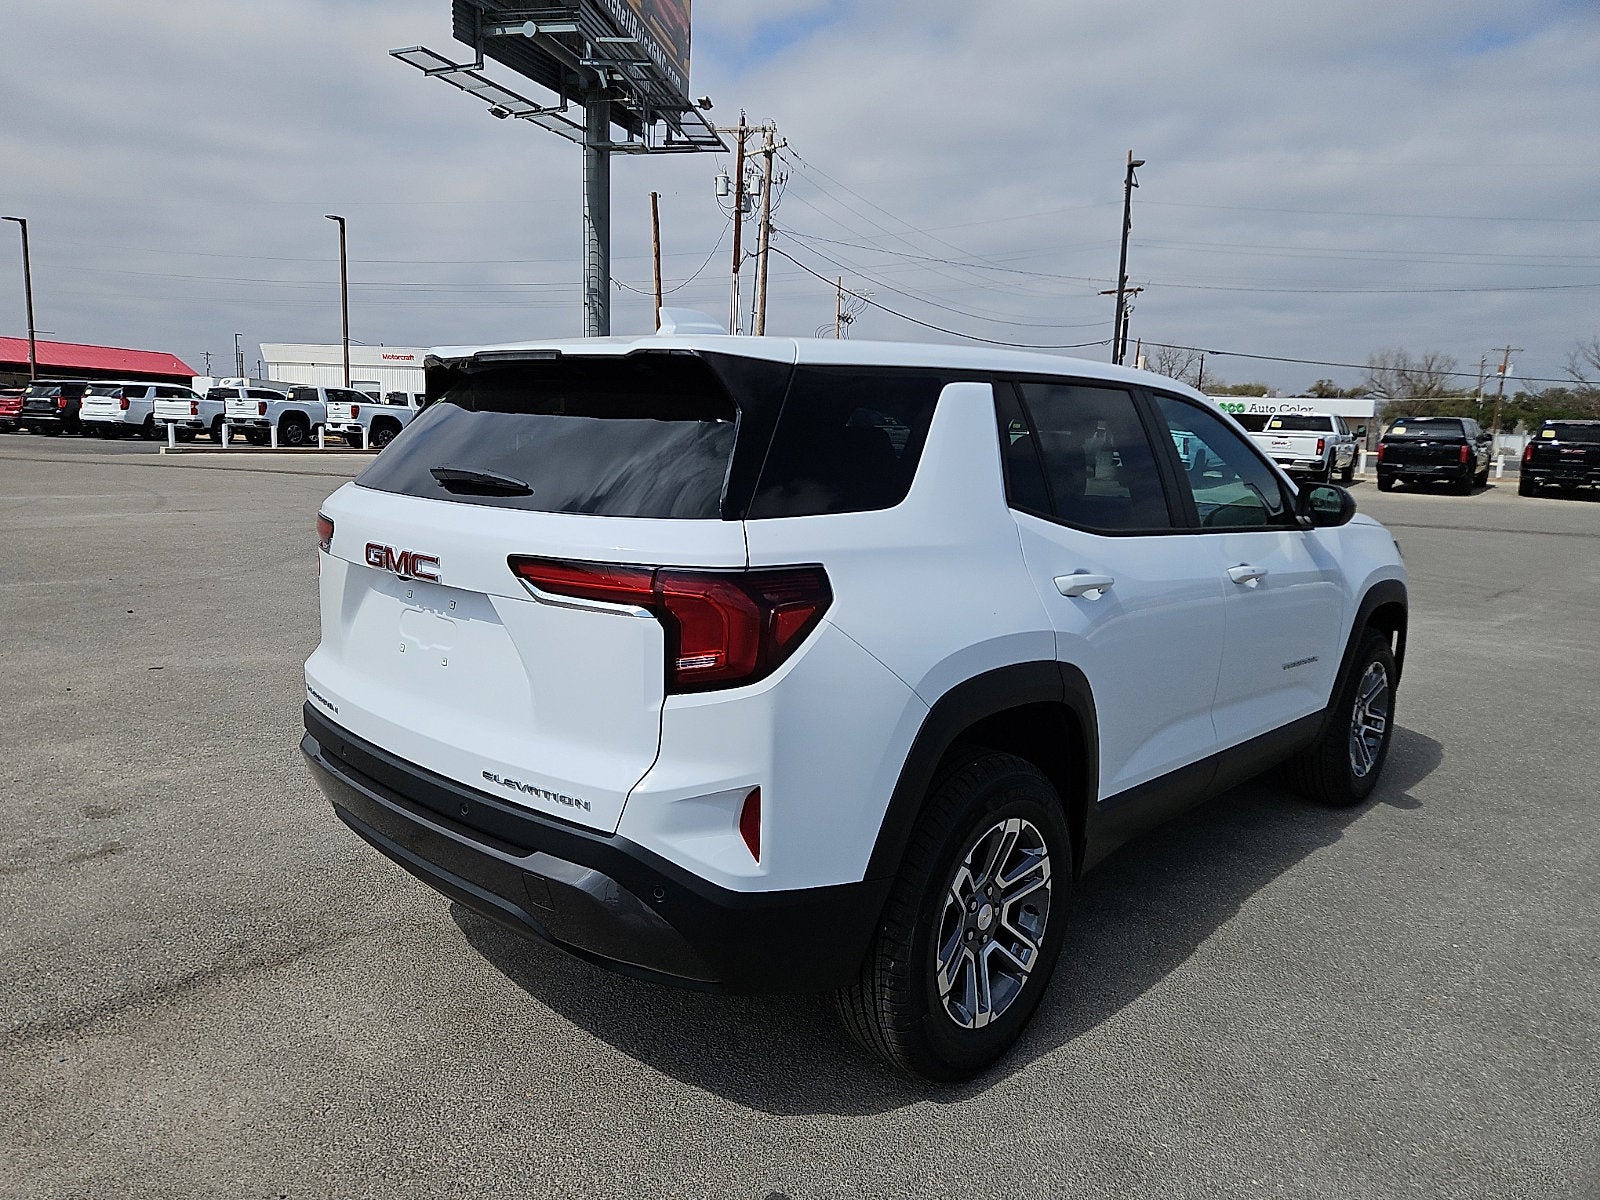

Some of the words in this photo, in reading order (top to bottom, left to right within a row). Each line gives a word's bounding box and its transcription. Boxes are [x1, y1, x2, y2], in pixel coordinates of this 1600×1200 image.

[382, 353, 415, 361] Motorcraft
[1249, 403, 1277, 413] Auto
[365, 540, 442, 584] GMC
[482, 769, 592, 813] ELEVATION
